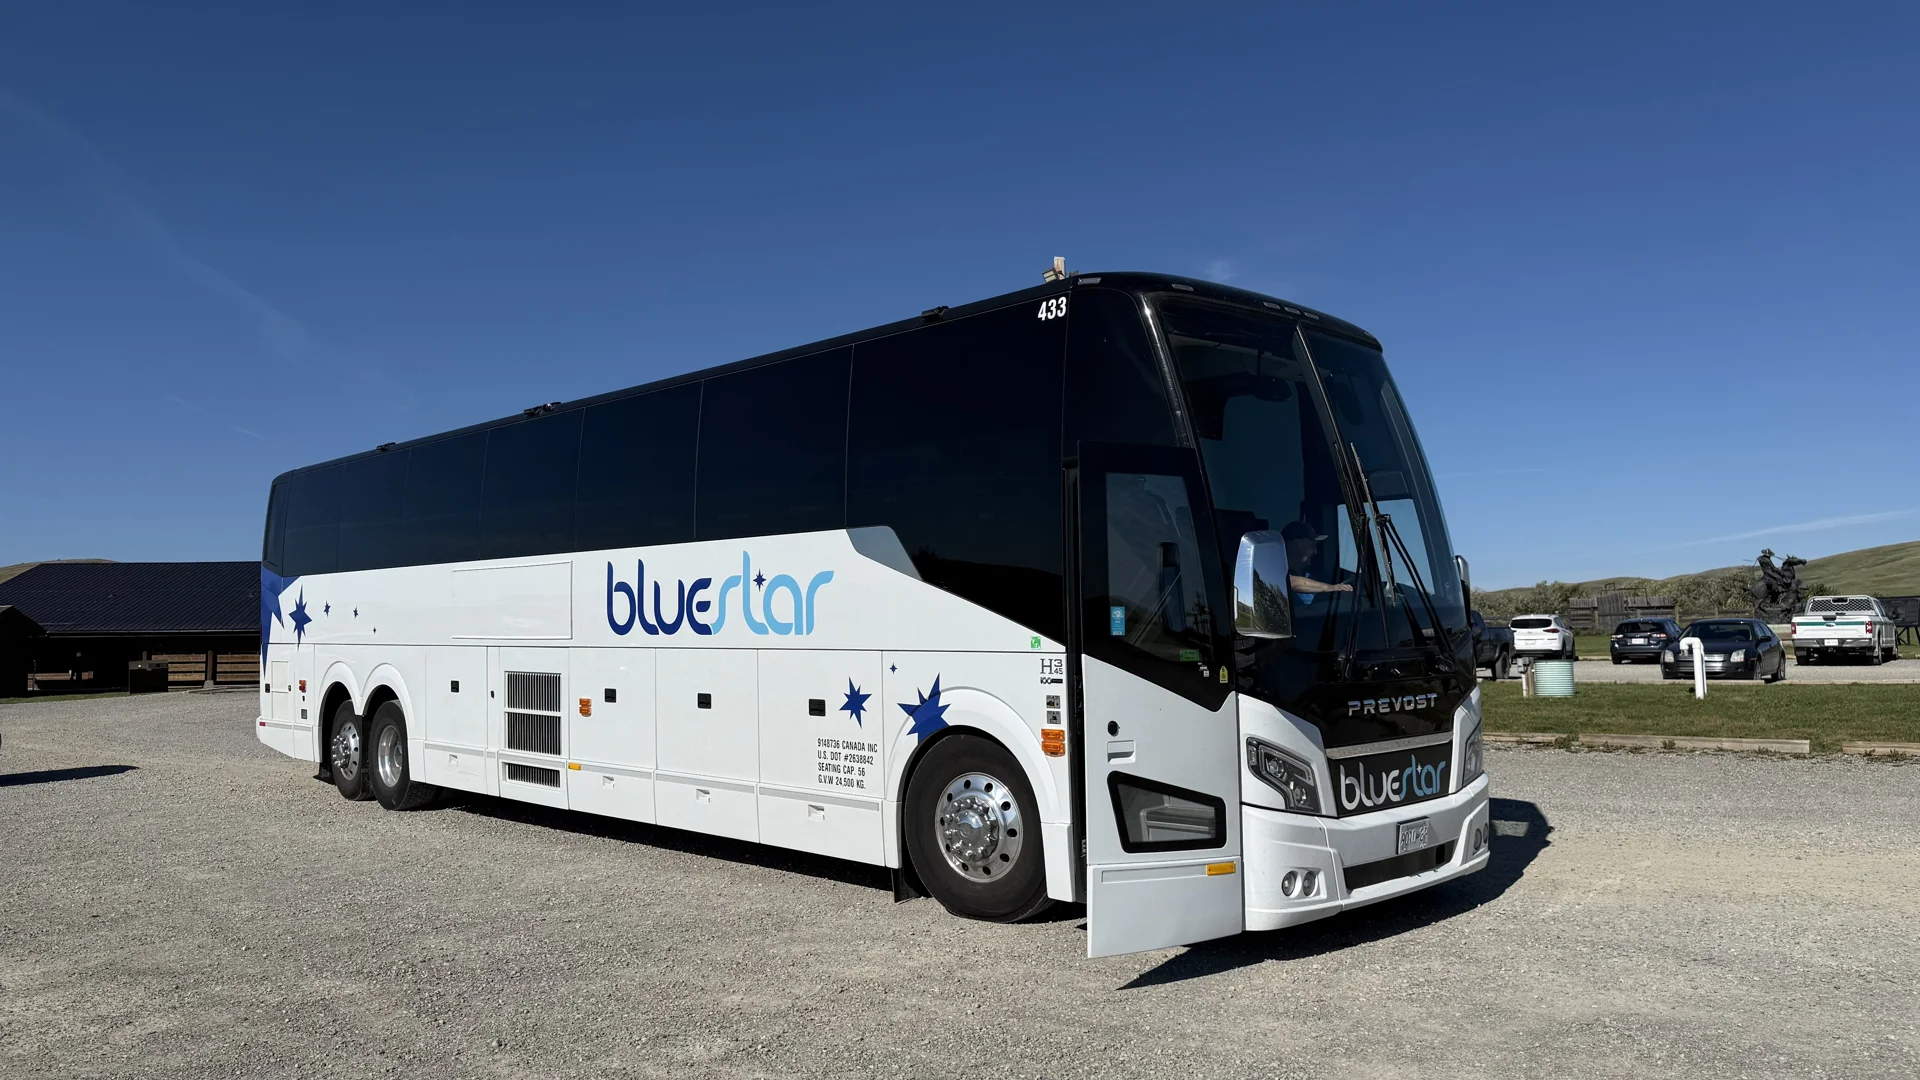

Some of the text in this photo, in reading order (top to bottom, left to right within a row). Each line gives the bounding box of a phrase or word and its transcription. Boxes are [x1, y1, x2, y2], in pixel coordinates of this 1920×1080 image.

[1038, 296, 1067, 321] 433
[607, 550, 834, 636] bluestar
[1348, 693, 1437, 716] PREVOST
[818, 738, 878, 753] 9148736 CANADA INC
[818, 750, 828, 760] U.S.
[831, 751, 842, 762] DOT
[818, 762, 865, 776] SEATING CAP. 56
[1340, 754, 1446, 810] bluestar
